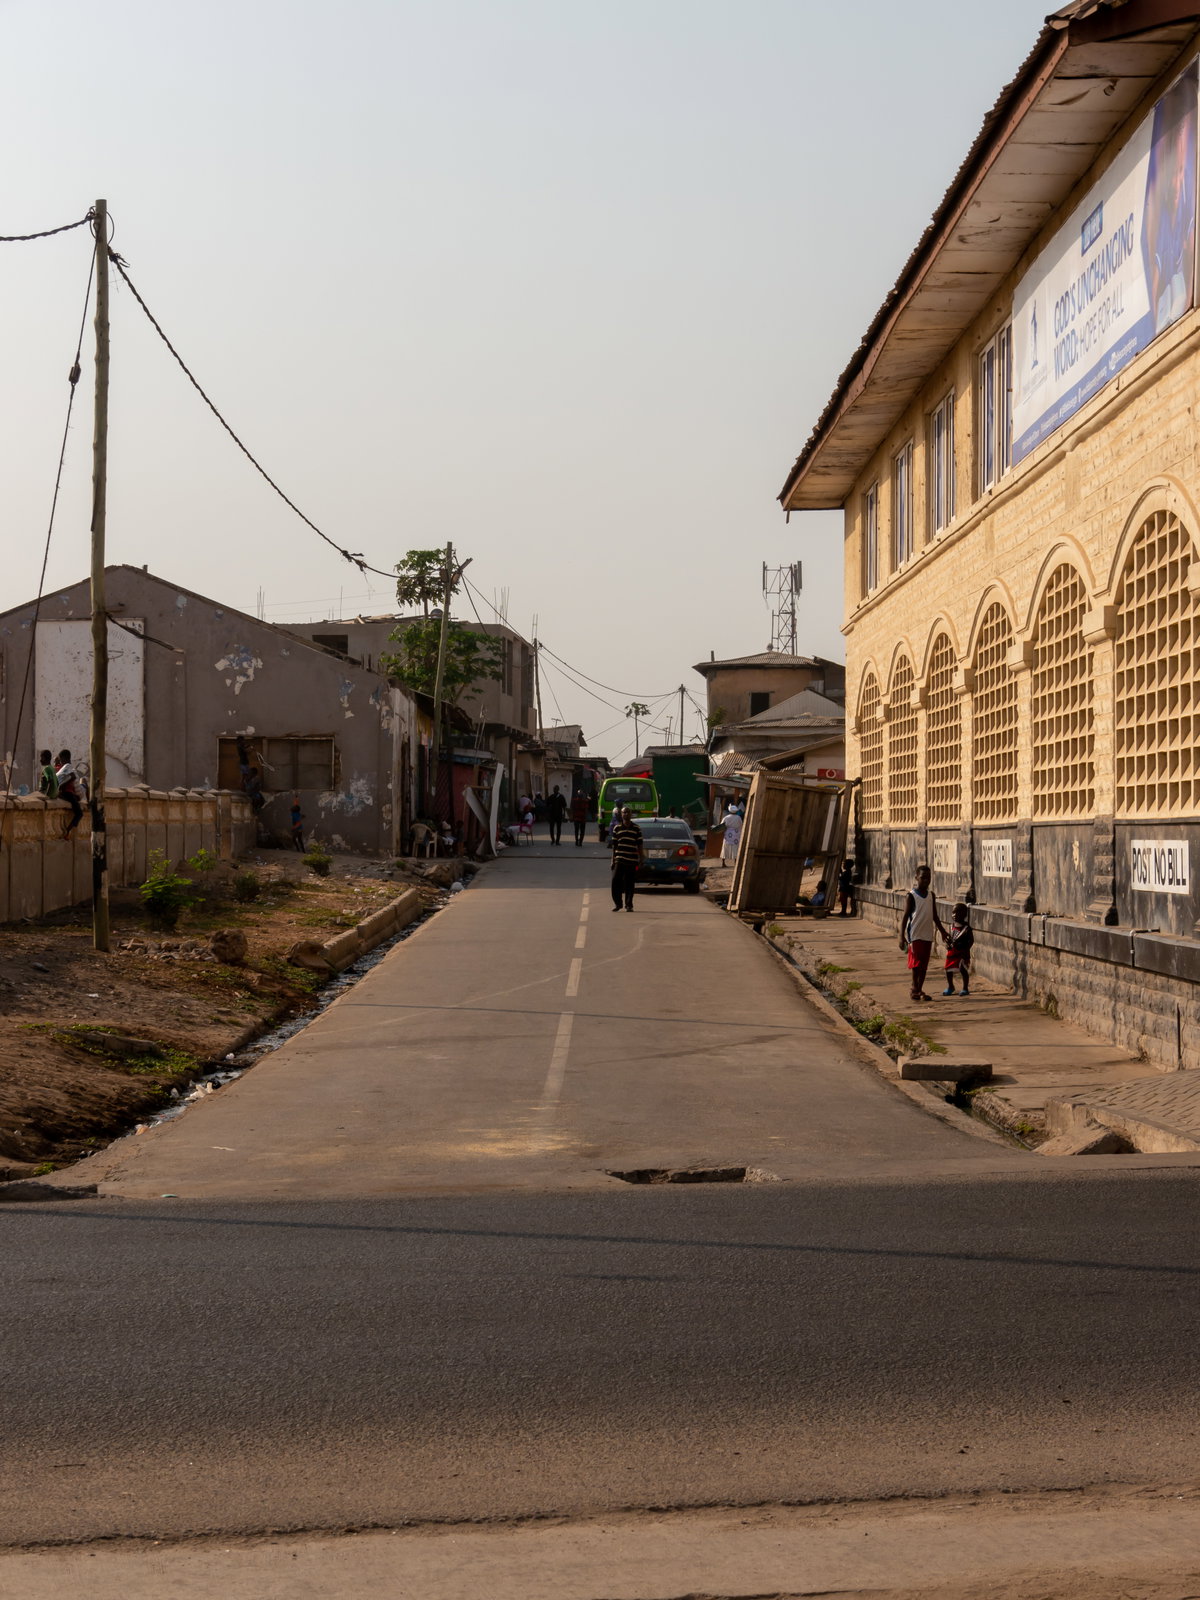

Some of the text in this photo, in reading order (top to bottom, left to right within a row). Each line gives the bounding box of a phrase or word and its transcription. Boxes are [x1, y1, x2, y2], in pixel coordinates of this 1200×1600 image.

[1077, 212, 1134, 314] UNCHANGING
[1079, 311, 1097, 360] HOPE
[1098, 295, 1110, 336] FOR
[1111, 280, 1125, 321] ALL
[1132, 847, 1187, 887] POST NO BILL
